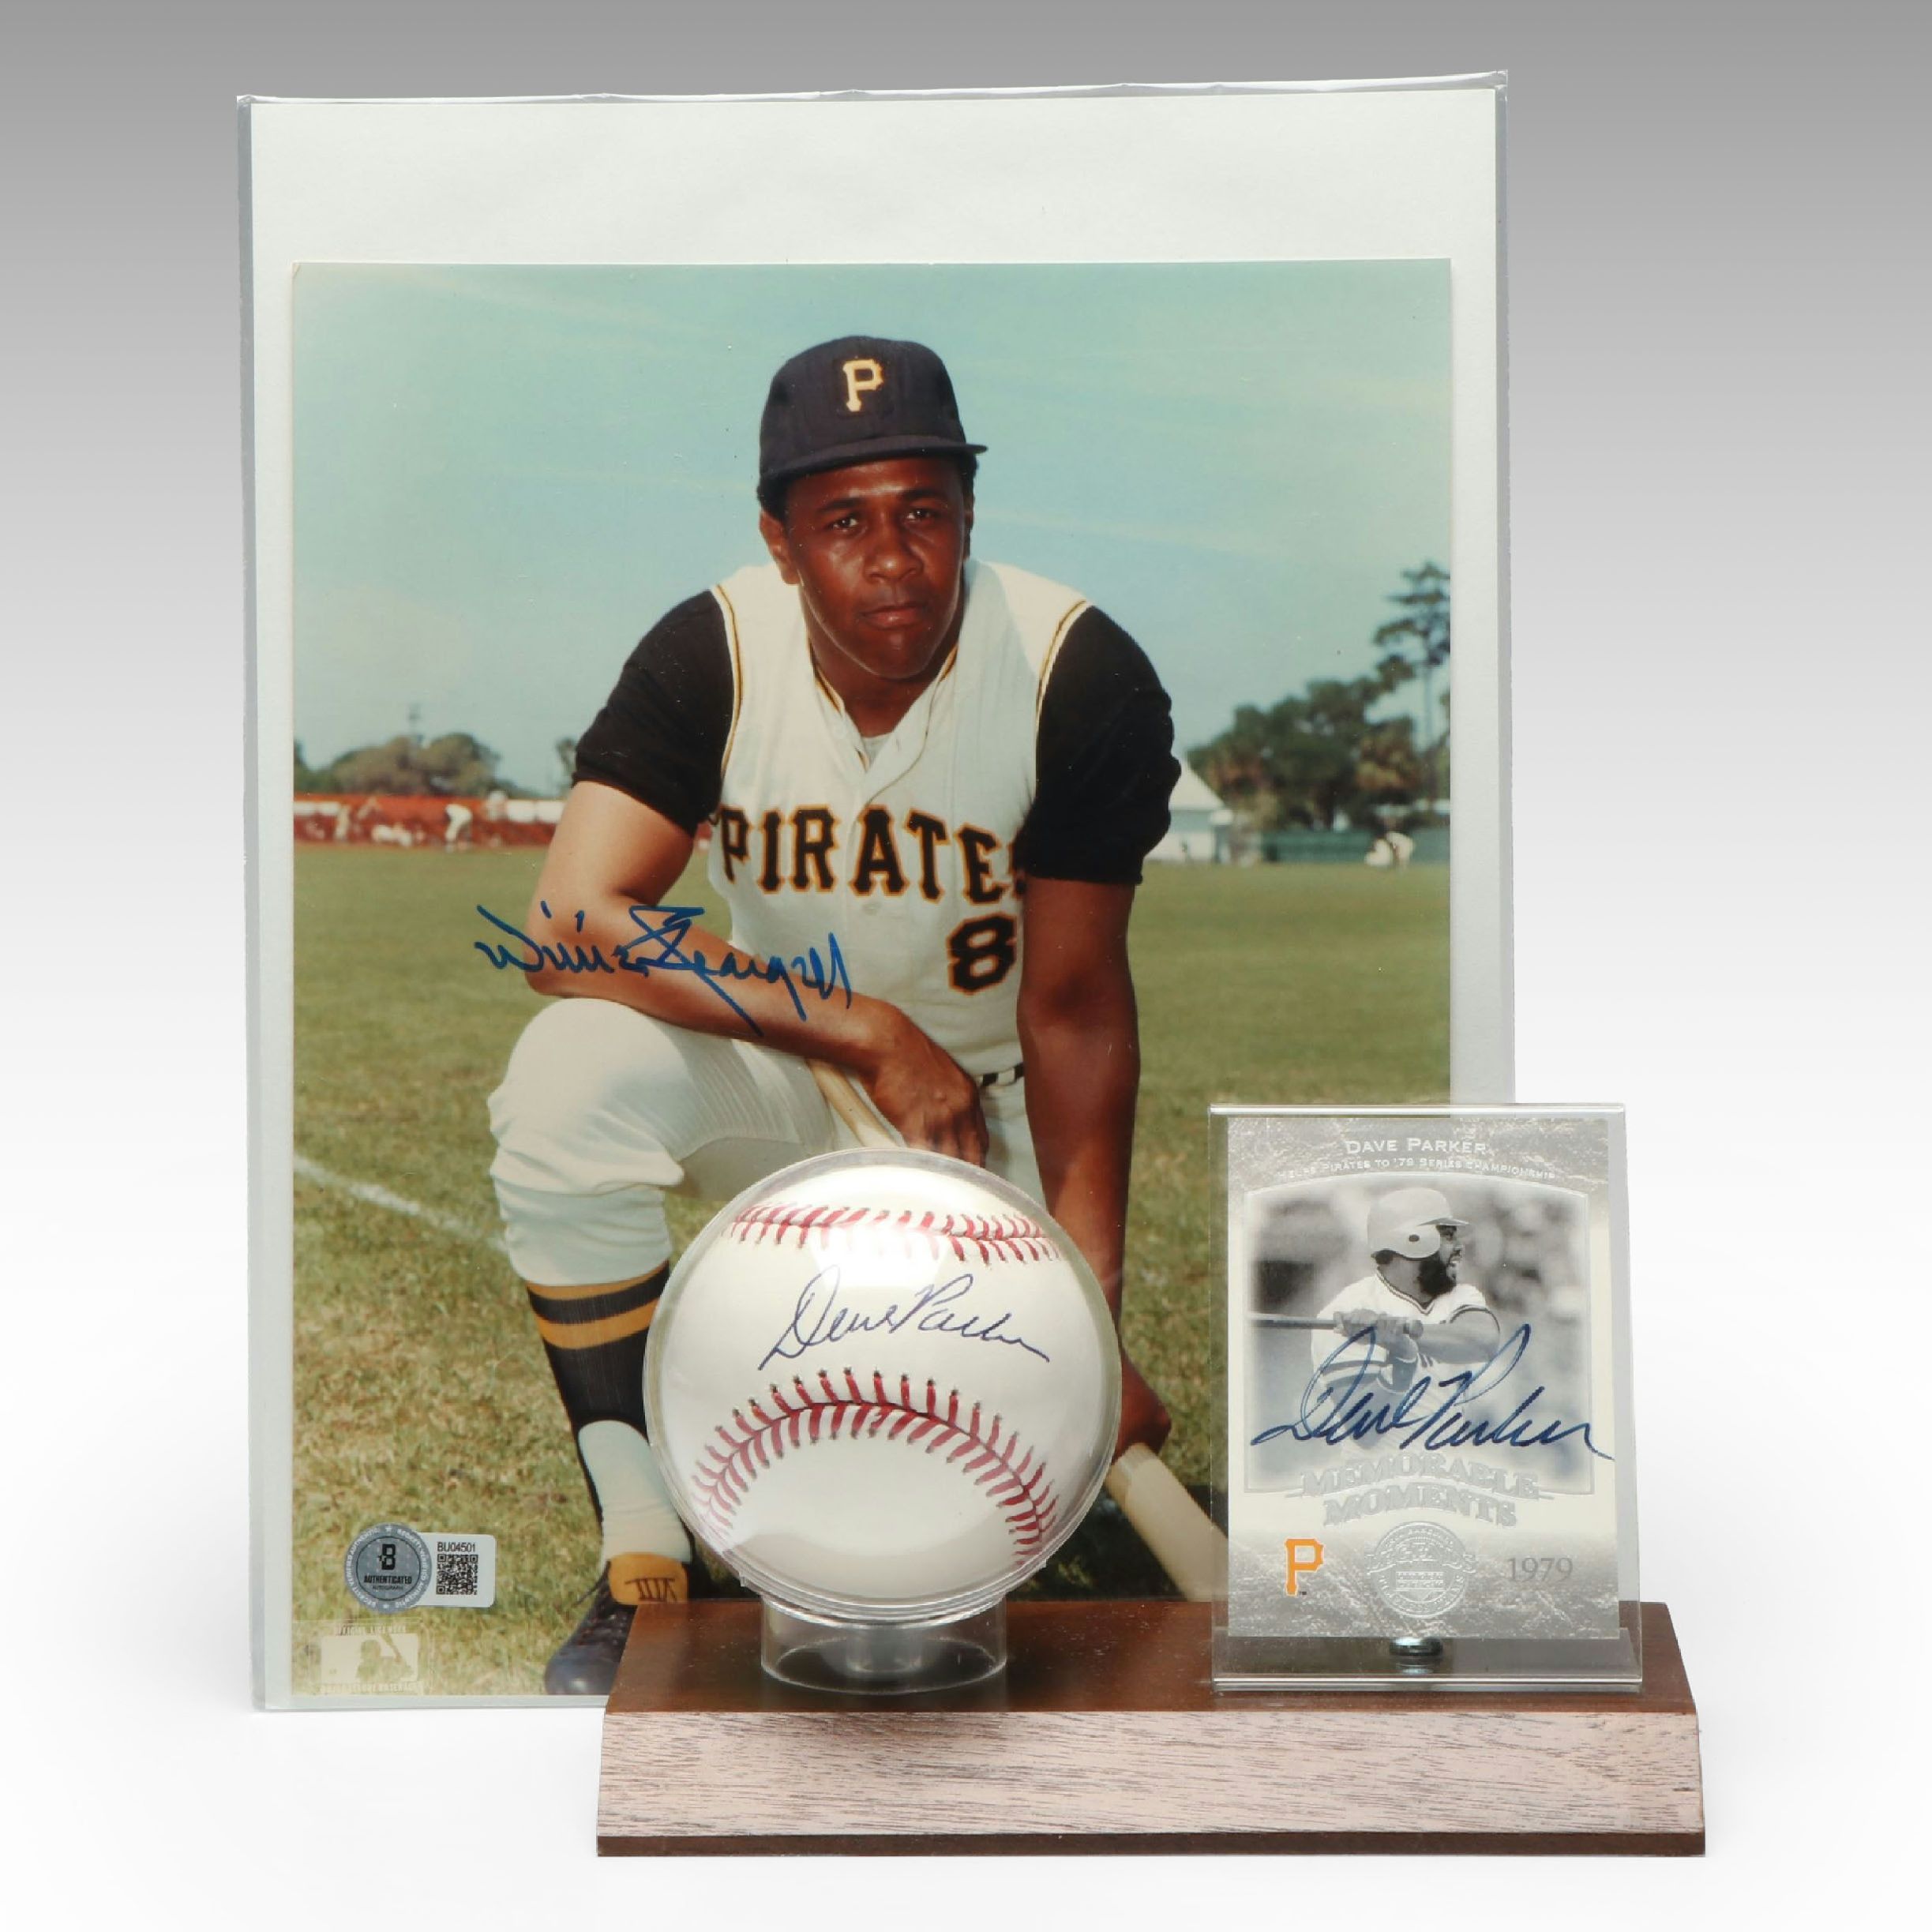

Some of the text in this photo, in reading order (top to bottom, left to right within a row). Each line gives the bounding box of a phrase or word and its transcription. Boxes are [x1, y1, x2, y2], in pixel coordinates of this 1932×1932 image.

[842, 358, 883, 412] P
[718, 804, 1024, 903] PIRATE
[945, 912, 1019, 995] 8
[1345, 1137, 1487, 1155] DAVE PARKER
[1375, 1159, 1390, 1168] TO
[1300, 1451, 1540, 1499] MEMORABLE
[1322, 1481, 1517, 1527] MOMENTS
[437, 1541, 476, 1553] BU04501
[1284, 1536, 1326, 1597] P
[1507, 1557, 1573, 1581] 1979
[363, 1574, 412, 1585] AUTHENTICATED
